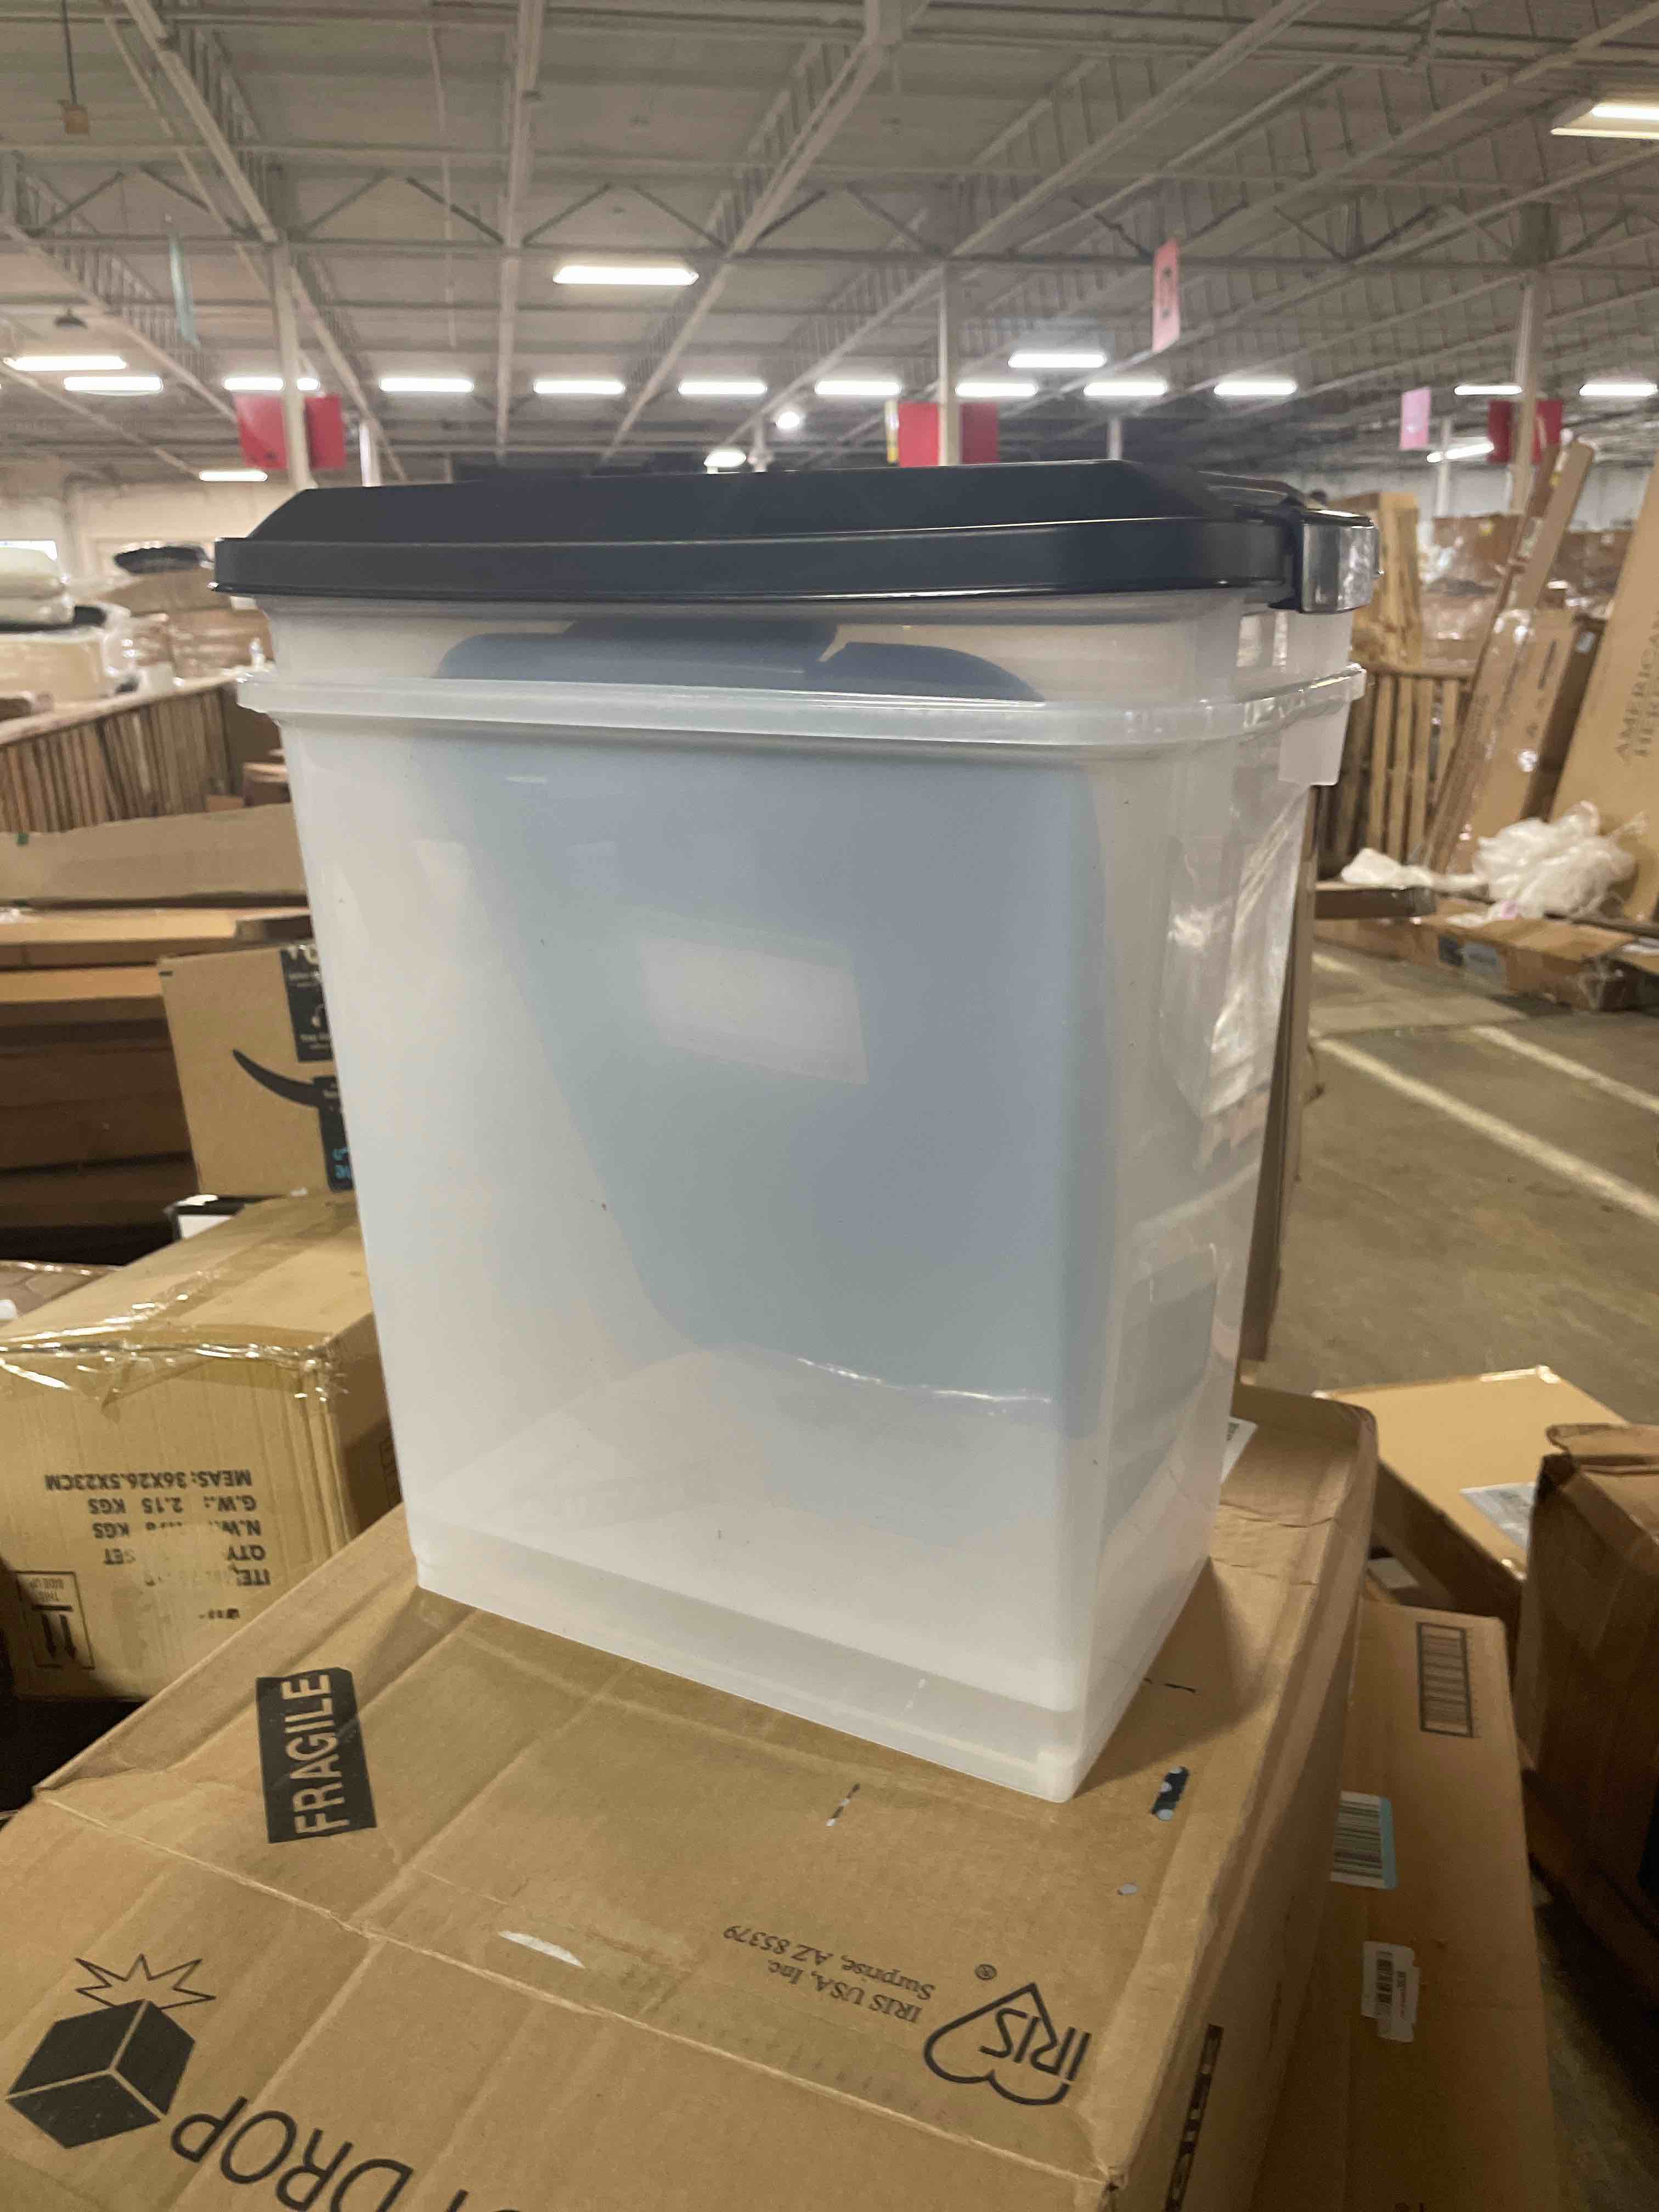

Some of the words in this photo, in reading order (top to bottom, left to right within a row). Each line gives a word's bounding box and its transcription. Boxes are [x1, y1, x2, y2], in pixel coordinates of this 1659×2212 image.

[190, 1470, 252, 1488] MEAS:
[88, 1498, 126, 1514] KGS
[142, 1497, 184, 1514] 2.15
[92, 1522, 129, 1538] KGS
[280, 1674, 350, 1834] FRAGILE
[723, 1925, 791, 1955] 85379
[792, 1944, 834, 1966] AZ
[767, 1958, 804, 1985] Inc.
[842, 1954, 936, 2001] Surprise,
[811, 1970, 864, 2005] USA,
[870, 1994, 922, 2024] IRIS
[979, 2007, 1092, 2081] IRIS
[170, 2096, 414, 2212] DROP
